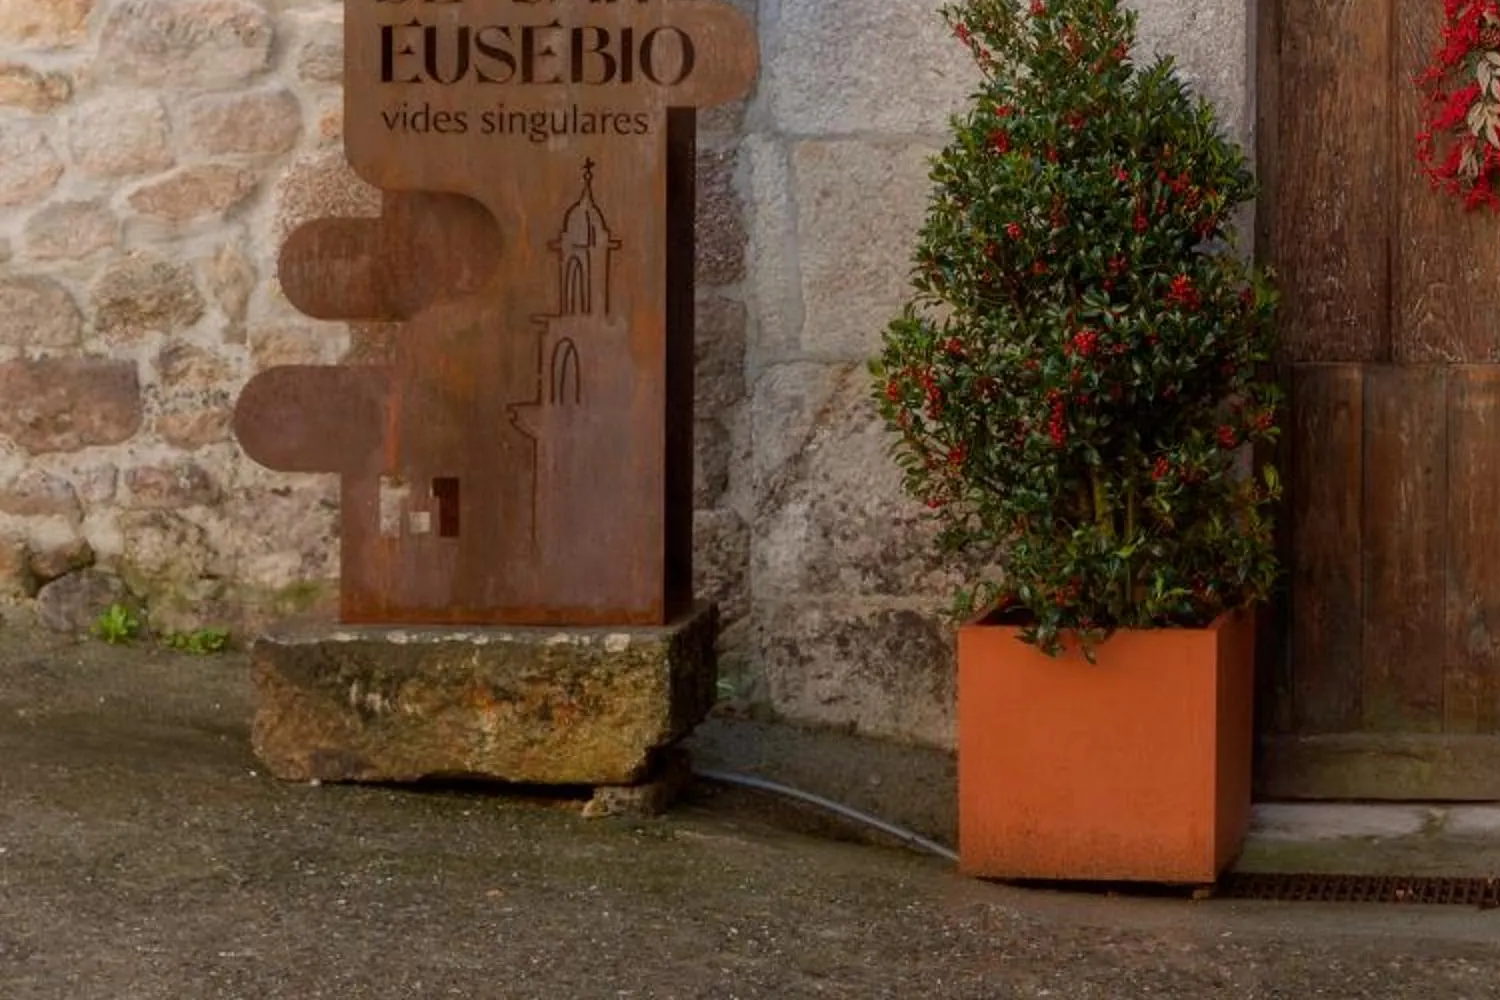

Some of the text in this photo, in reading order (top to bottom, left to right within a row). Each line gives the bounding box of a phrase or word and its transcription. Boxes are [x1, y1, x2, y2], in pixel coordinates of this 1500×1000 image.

[377, 18, 695, 86] EUSEBIO
[381, 105, 649, 143] vides singulares
